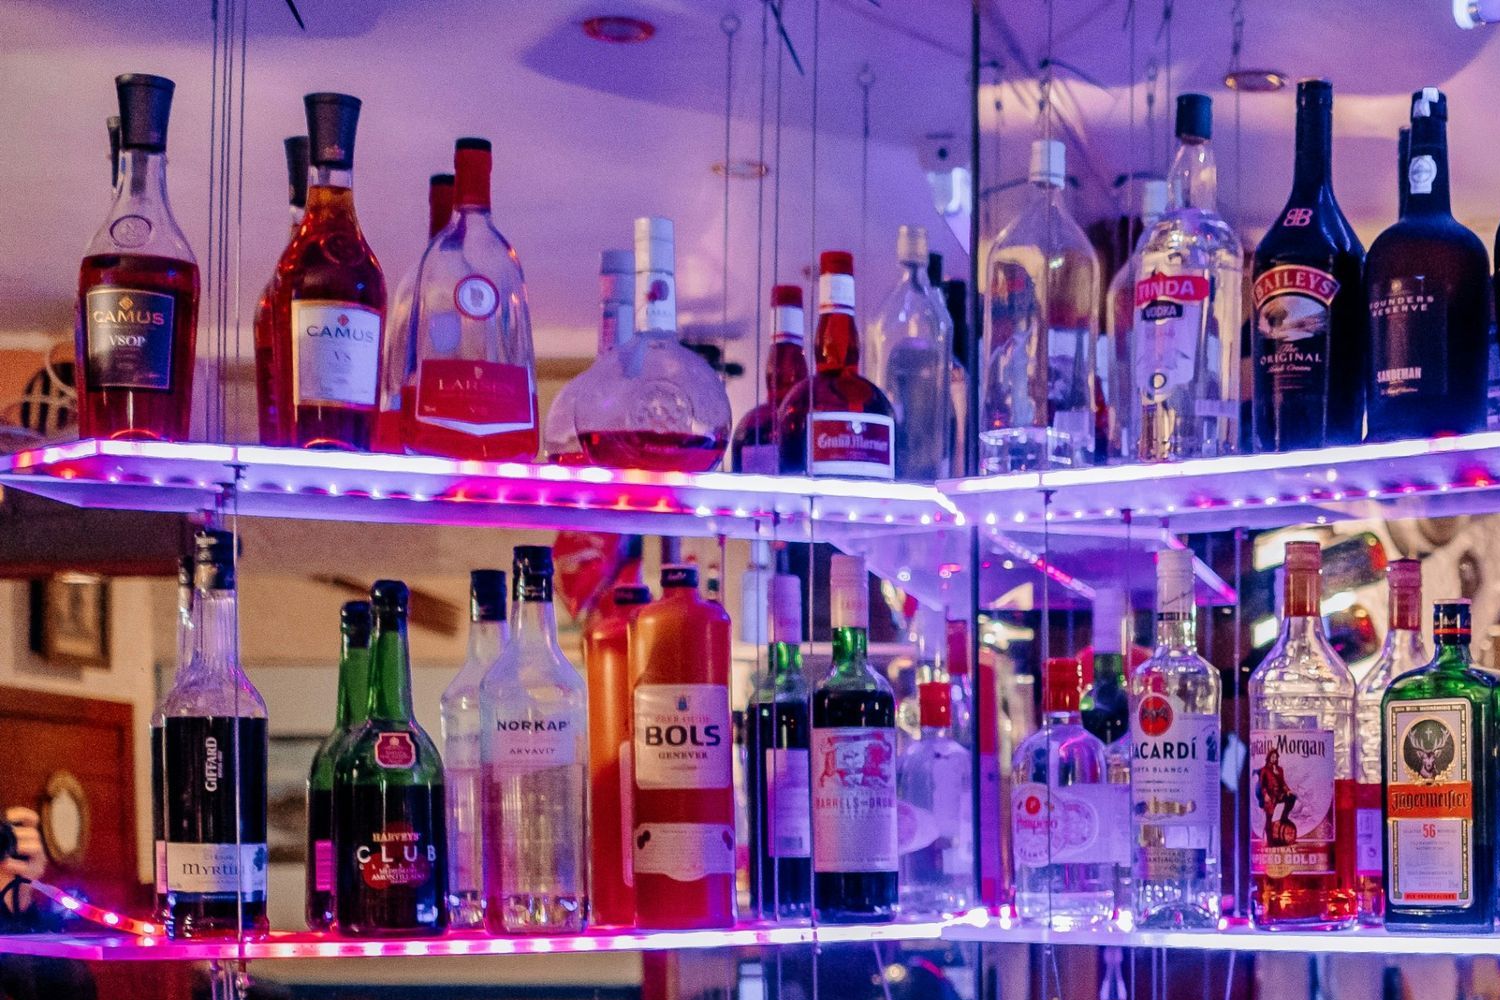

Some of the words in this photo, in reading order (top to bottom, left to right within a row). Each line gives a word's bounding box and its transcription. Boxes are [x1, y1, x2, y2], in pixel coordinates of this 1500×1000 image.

[1255, 271, 1334, 299] BAILEYS
[1369, 295, 1434, 311] FOUNDERS
[93, 309, 164, 326] CAMUS
[109, 335, 147, 347] VSOP
[306, 324, 374, 344] CAMUS
[1260, 352, 1323, 366] ORIGINAL
[646, 725, 720, 746] BOLS
[1133, 736, 1197, 760] ACARDÍ
[1250, 739, 1273, 758] ptain
[1276, 734, 1326, 758] Morgan
[205, 737, 218, 792] GIFFARD
[1153, 766, 1189, 774] BLANCA
[372, 832, 419, 842] HARVEYS
[1422, 823, 1437, 838] 56
[356, 845, 437, 863] CLUB
[1284, 853, 1318, 865] GOLD
